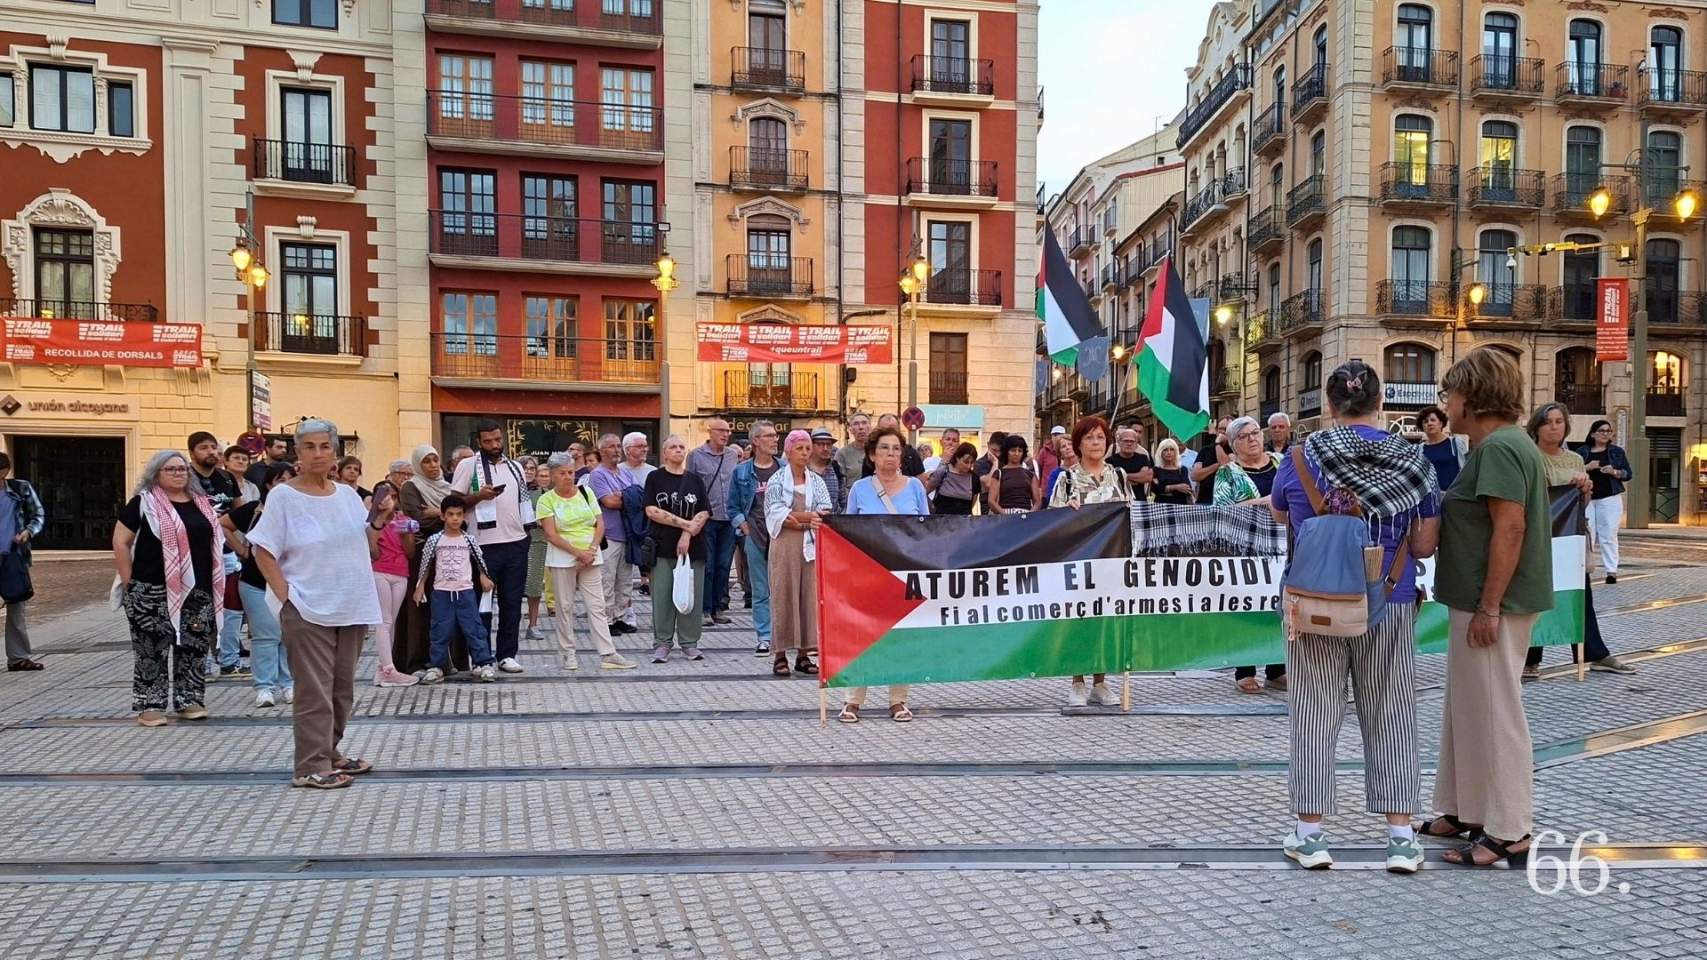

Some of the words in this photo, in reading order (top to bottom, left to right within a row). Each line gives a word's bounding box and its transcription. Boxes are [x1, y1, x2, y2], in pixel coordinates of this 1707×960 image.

[15, 320, 51, 328] TRAIL
[88, 323, 125, 331] TRAIL
[163, 325, 198, 333] TRAIL
[708, 325, 741, 333] TRAIL
[758, 326, 793, 334] TRAIL
[809, 327, 841, 335] TRAIL
[857, 327, 890, 335] TRAIL
[44, 348, 100, 358] RECOLLIDA
[102, 350, 115, 359] DE
[117, 350, 164, 360] DORSALS
[28, 399, 66, 412] unión
[68, 400, 129, 416] alcoyana
[905, 566, 1040, 600] ATUREM
[1064, 562, 1096, 590] EL
[1123, 558, 1272, 588] GENOCIDI
[997, 600, 1087, 622] comerç
